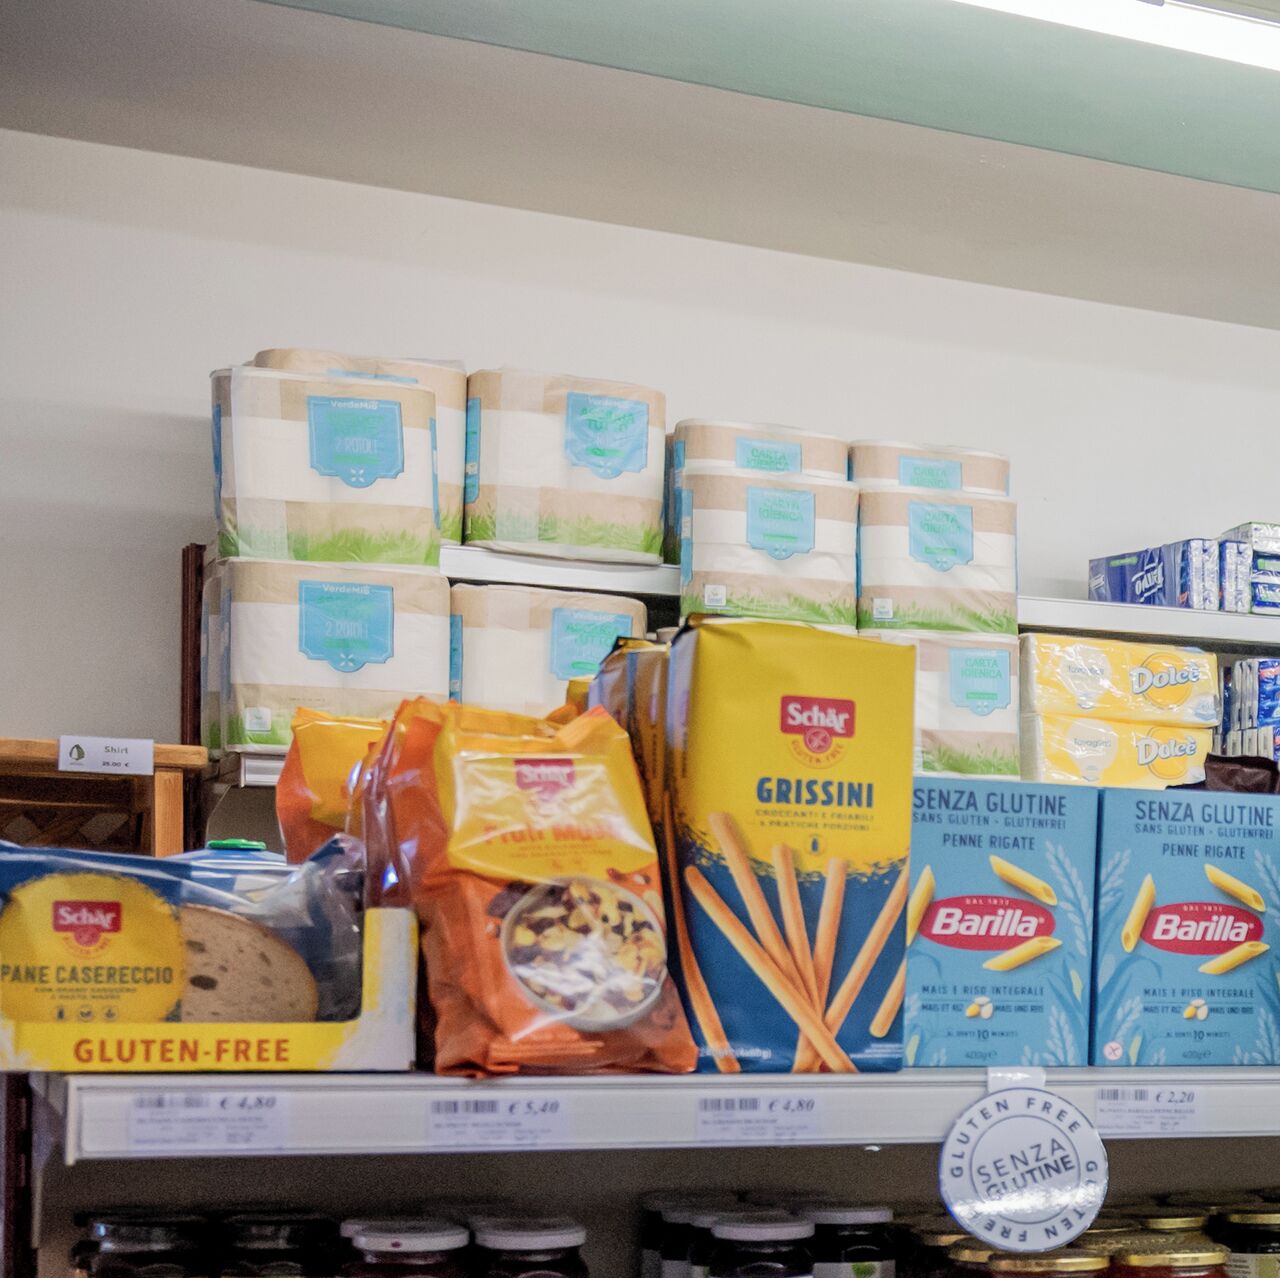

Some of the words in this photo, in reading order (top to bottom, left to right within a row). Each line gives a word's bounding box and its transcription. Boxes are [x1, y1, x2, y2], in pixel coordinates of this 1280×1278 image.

[786, 702, 850, 733] Schär
[756, 777, 874, 809] GRISSINI
[913, 789, 979, 814] SENZA
[986, 792, 1067, 817] GLUTINE
[1135, 800, 1195, 824] SENZA
[1201, 804, 1274, 828] GLUTINE
[943, 834, 984, 849] PENNE
[989, 835, 1035, 851] RIGATE
[1135, 824, 1164, 835] SANS
[1167, 825, 1206, 836] GLUTEN
[1218, 827, 1274, 839] GLUTENFREI
[1162, 844, 1200, 858] PENNE
[1205, 845, 1245, 860] RIGATE
[58, 907, 117, 932] Schär
[931, 908, 1038, 937] Barilla
[1152, 914, 1248, 942] Barilla
[1, 966, 48, 984] PANE
[56, 966, 174, 985] CASERECCIO
[73, 1038, 291, 1063] GLUTEN-FREE
[1156, 1091, 1164, 1104] €
[1167, 1090, 1195, 1104] 2,20
[951, 1100, 1009, 1178] GLUTEN
[1027, 1097, 1081, 1133] FREE
[977, 1138, 1066, 1183] SENZA
